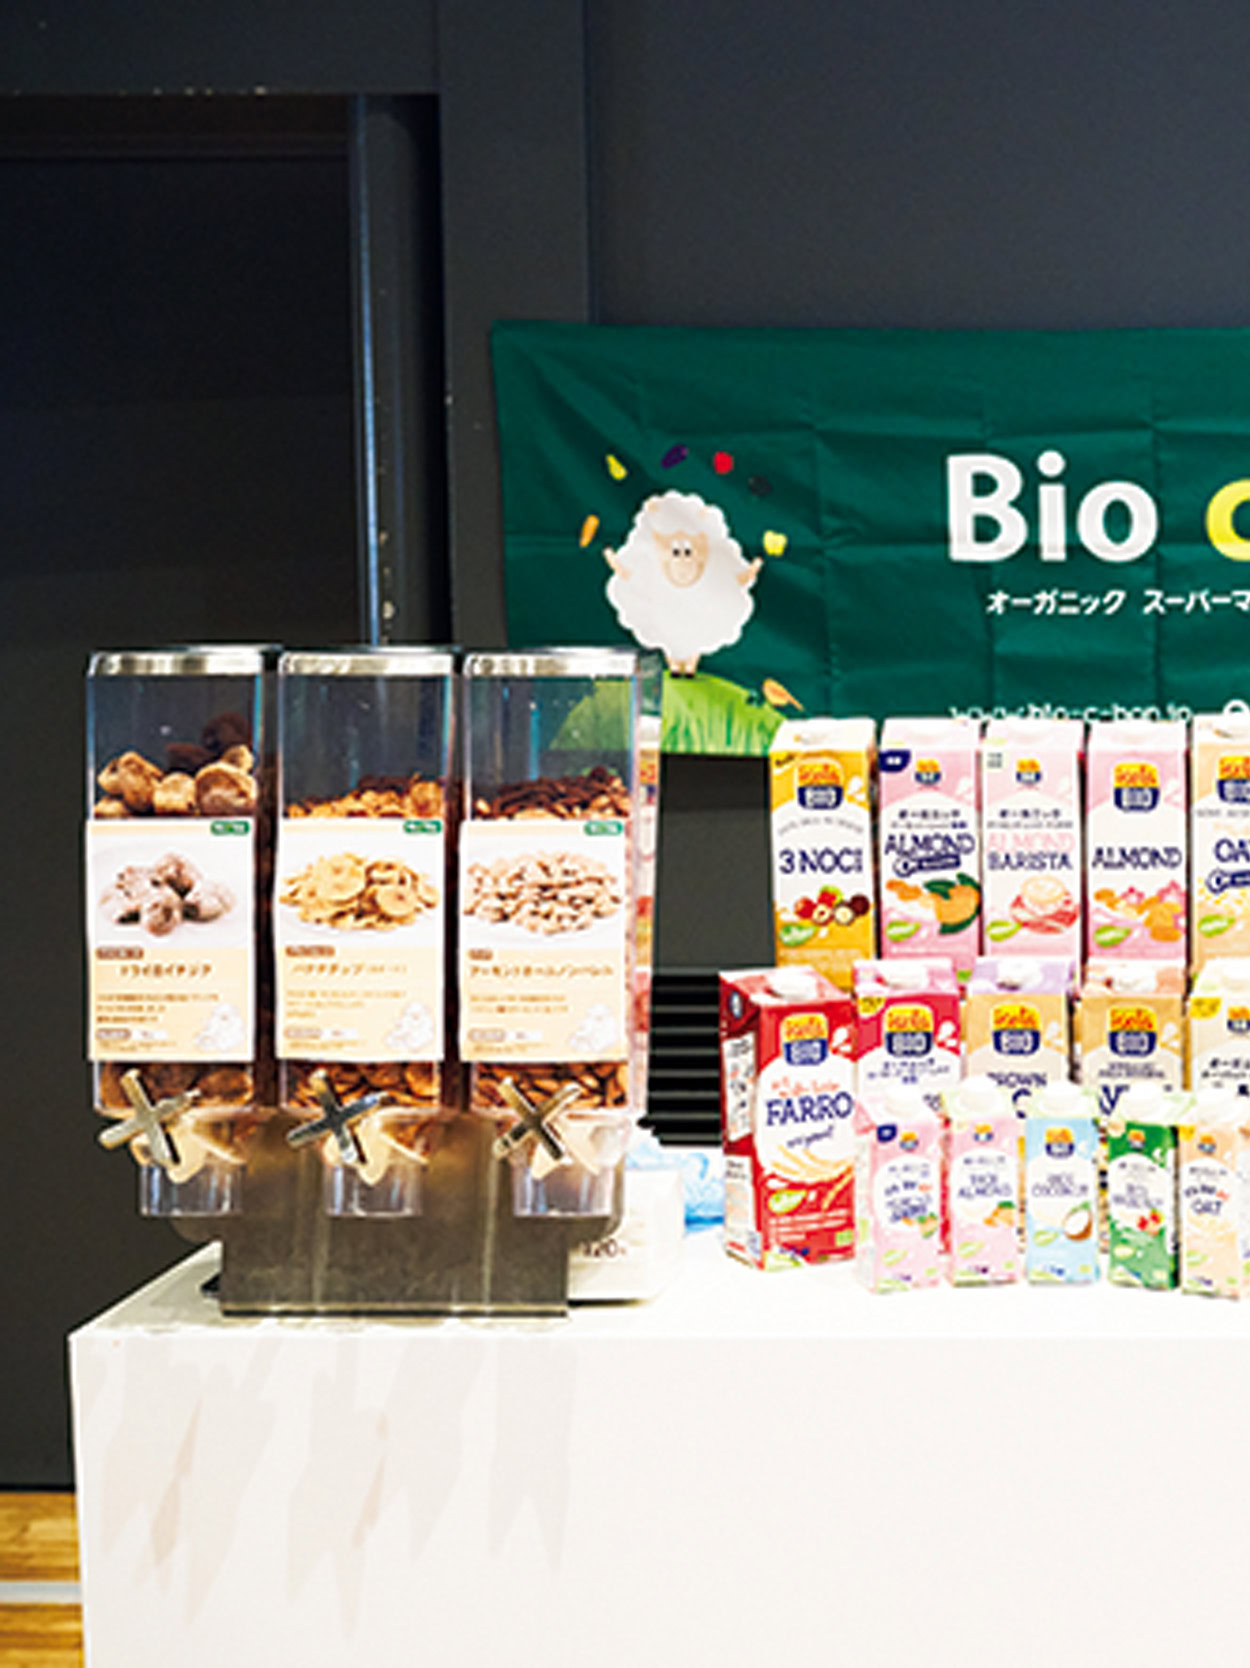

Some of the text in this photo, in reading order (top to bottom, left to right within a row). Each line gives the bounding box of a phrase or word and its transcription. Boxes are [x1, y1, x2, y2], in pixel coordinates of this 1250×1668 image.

[947, 450, 1159, 562] Bio
[986, 589, 1126, 616] オーガニック
[885, 833, 975, 856] ALMOND
[1092, 846, 1182, 869] ALMOND
[779, 849, 796, 874] 3
[799, 847, 863, 873] NOCI
[987, 852, 1073, 871] BARISTA
[765, 1091, 854, 1126] FARRO
